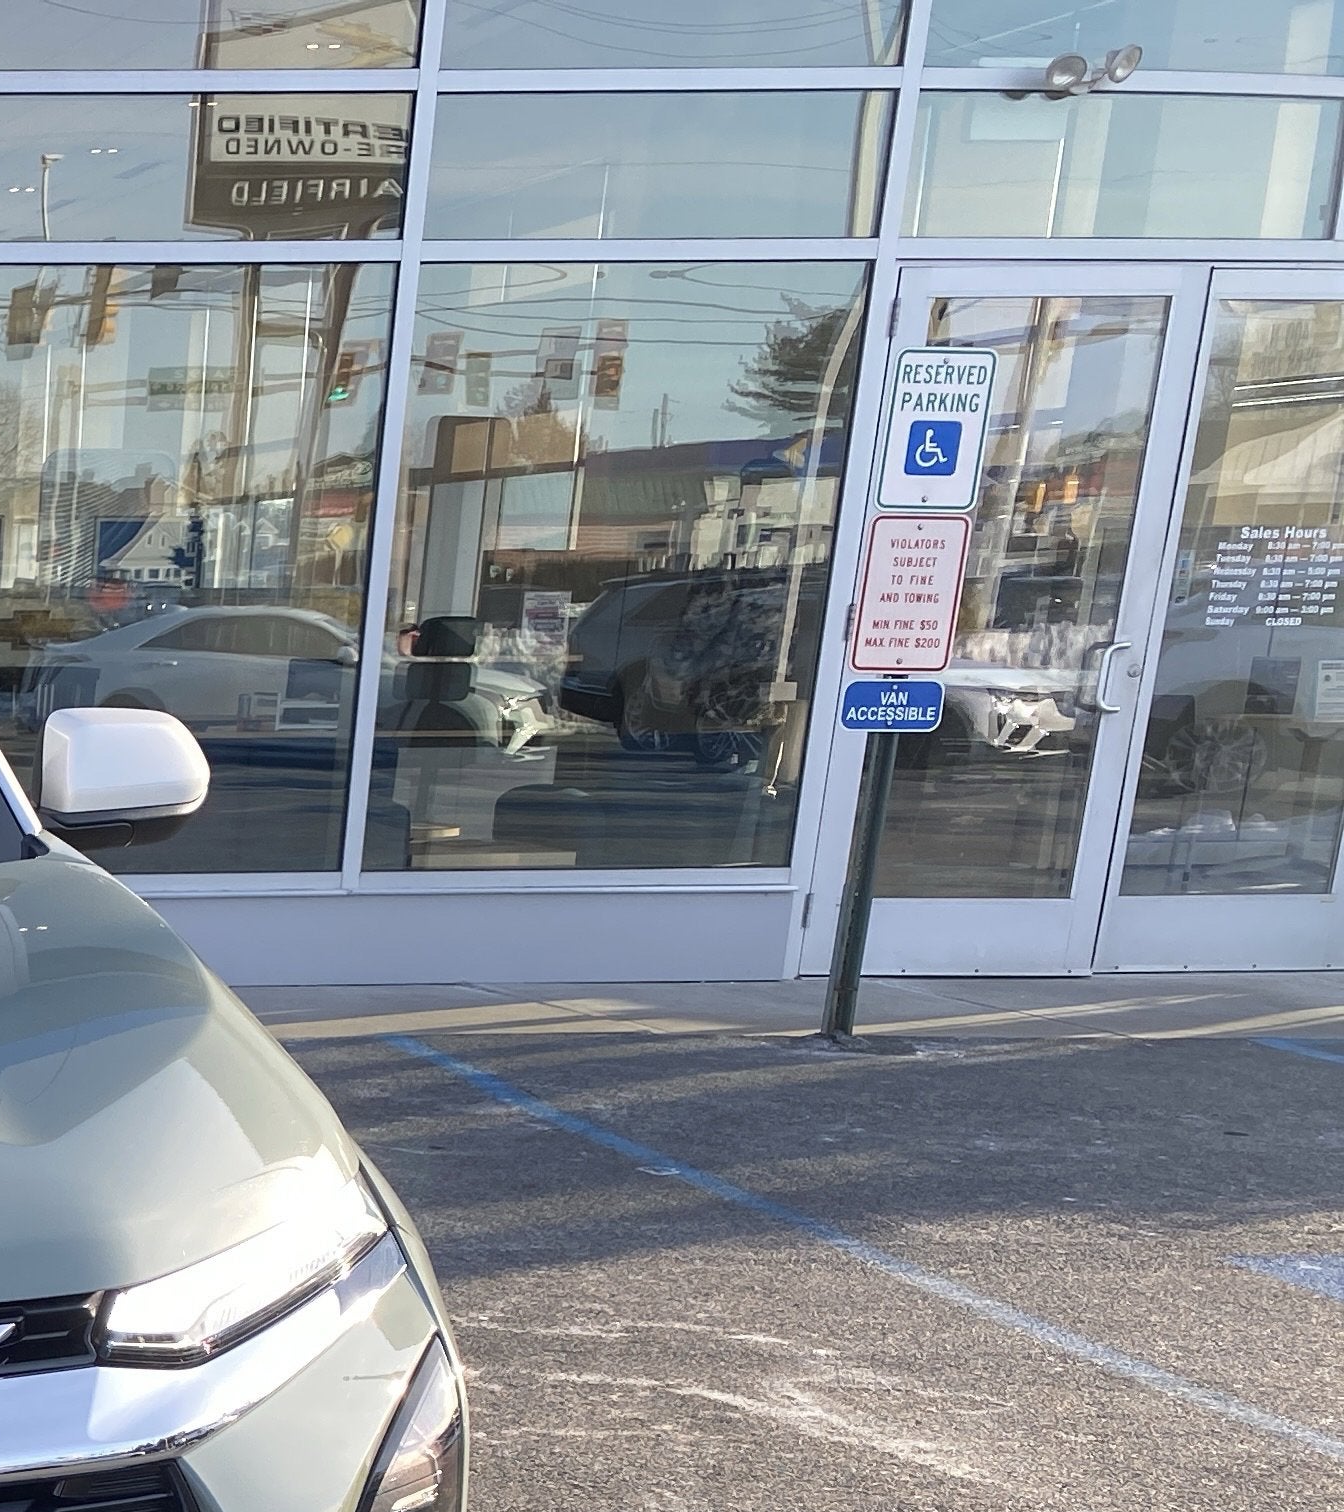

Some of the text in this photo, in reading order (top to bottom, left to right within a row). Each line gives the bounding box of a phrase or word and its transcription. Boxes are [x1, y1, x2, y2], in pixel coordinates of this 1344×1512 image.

[902, 364, 988, 385] RESERVED
[900, 392, 980, 412] PARKING
[1240, 526, 1327, 539] Sales Hours
[891, 538, 946, 550] VIOLATORS
[893, 556, 938, 568] SUBJECT
[891, 574, 934, 586] TO FINE
[879, 592, 940, 604] AND TOWING
[1208, 592, 1238, 603] Friday
[1206, 605, 1250, 616] Saturday
[894, 619, 915, 630] FINE
[919, 620, 938, 631] $50
[1265, 617, 1302, 626] CLOSED
[888, 637, 910, 648] FINE
[914, 637, 941, 648] $200
[880, 691, 909, 705] VAN
[846, 706, 937, 721] ACCESSIBLE
